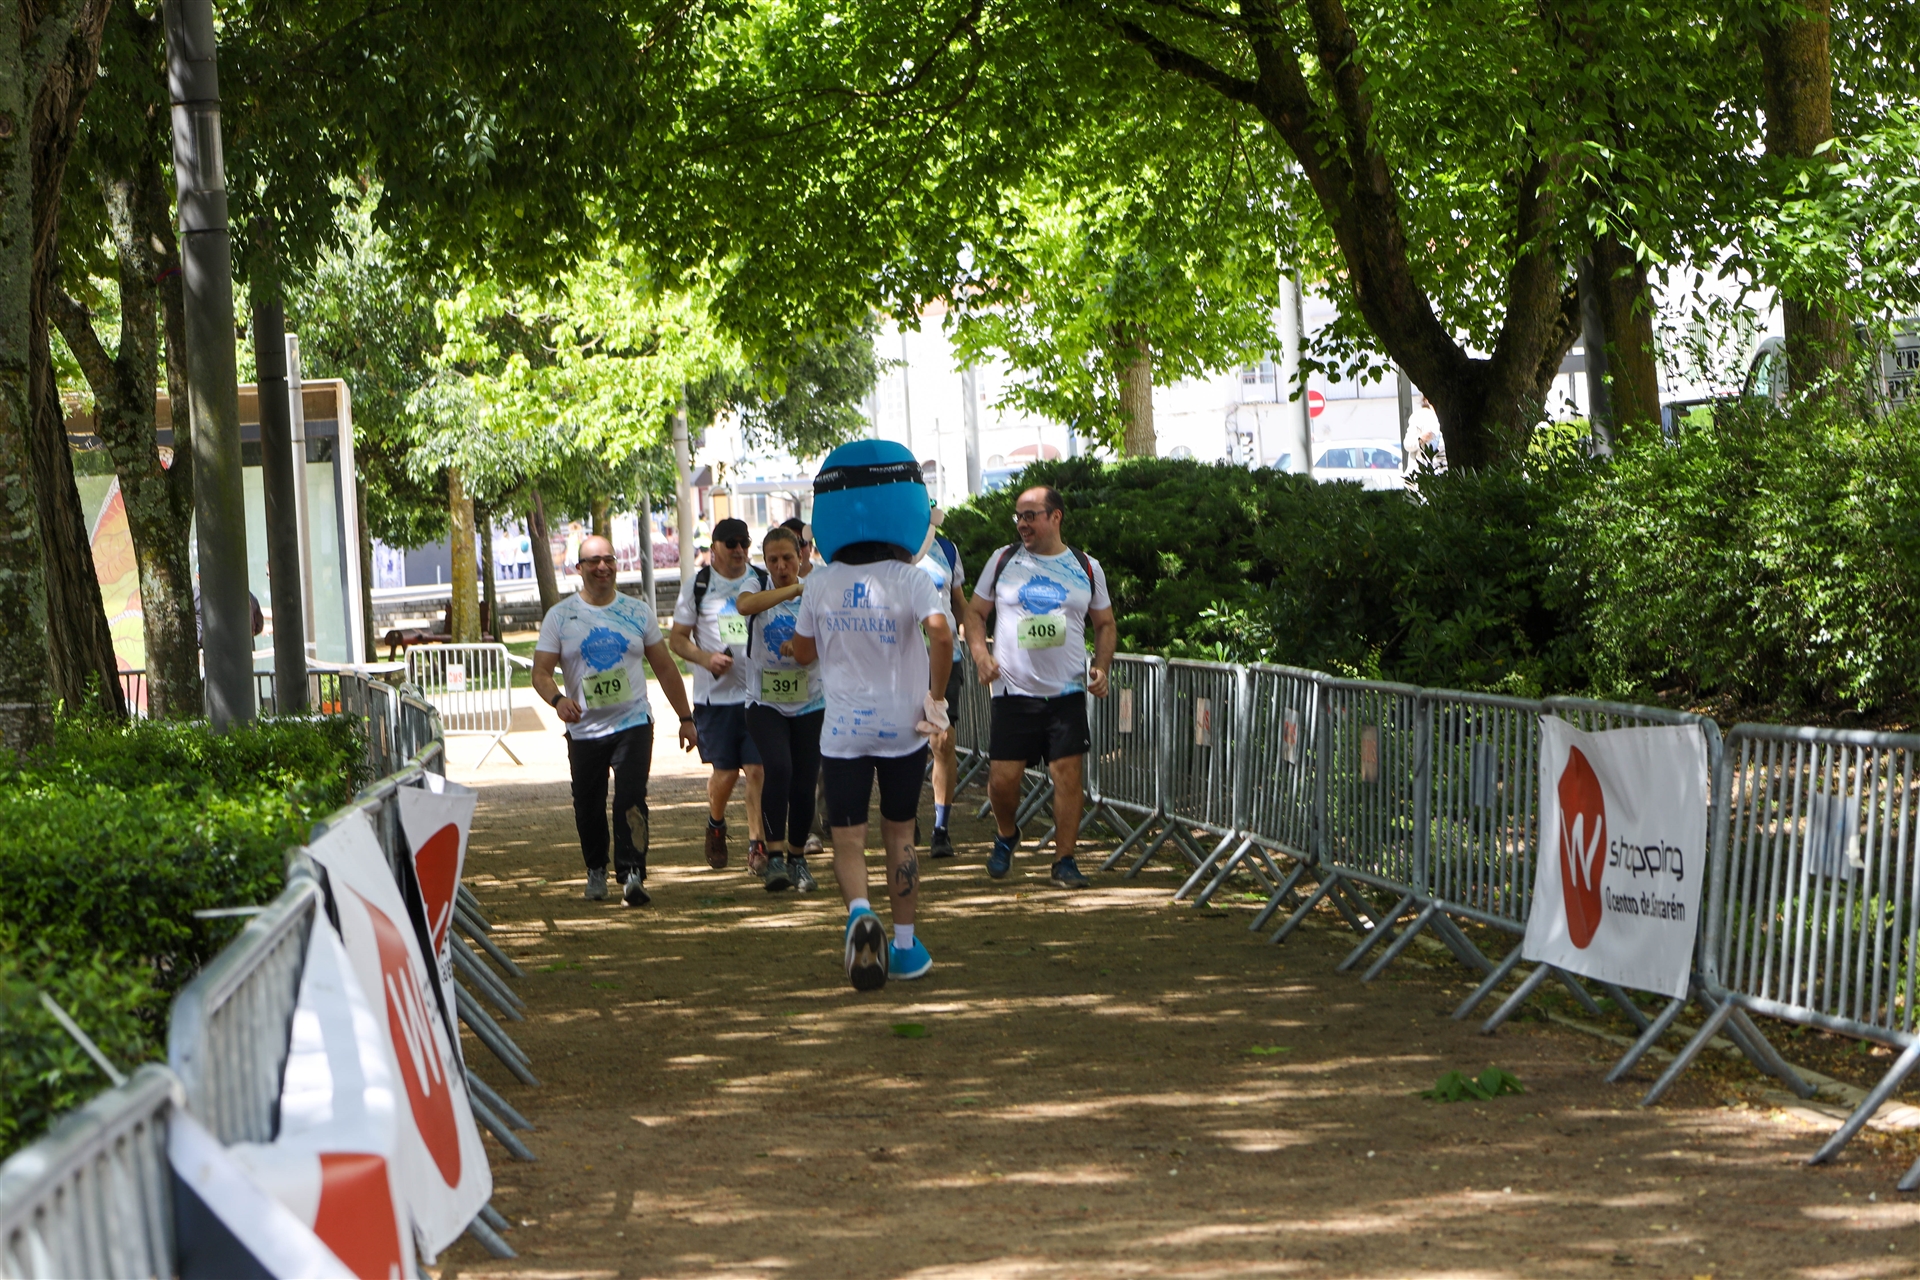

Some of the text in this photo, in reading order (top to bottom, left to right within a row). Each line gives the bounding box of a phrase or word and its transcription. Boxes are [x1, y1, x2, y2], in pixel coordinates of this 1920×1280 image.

[826, 614, 896, 633] SANTARÉM
[1028, 624, 1056, 637] 408
[879, 636, 896, 644] TRAIL
[448, 671, 463, 683] CMS
[772, 679, 798, 692] 391
[594, 678, 621, 696] 479
[1560, 807, 1602, 892] W
[1609, 834, 1684, 882] shopping
[1612, 894, 1639, 915] centro
